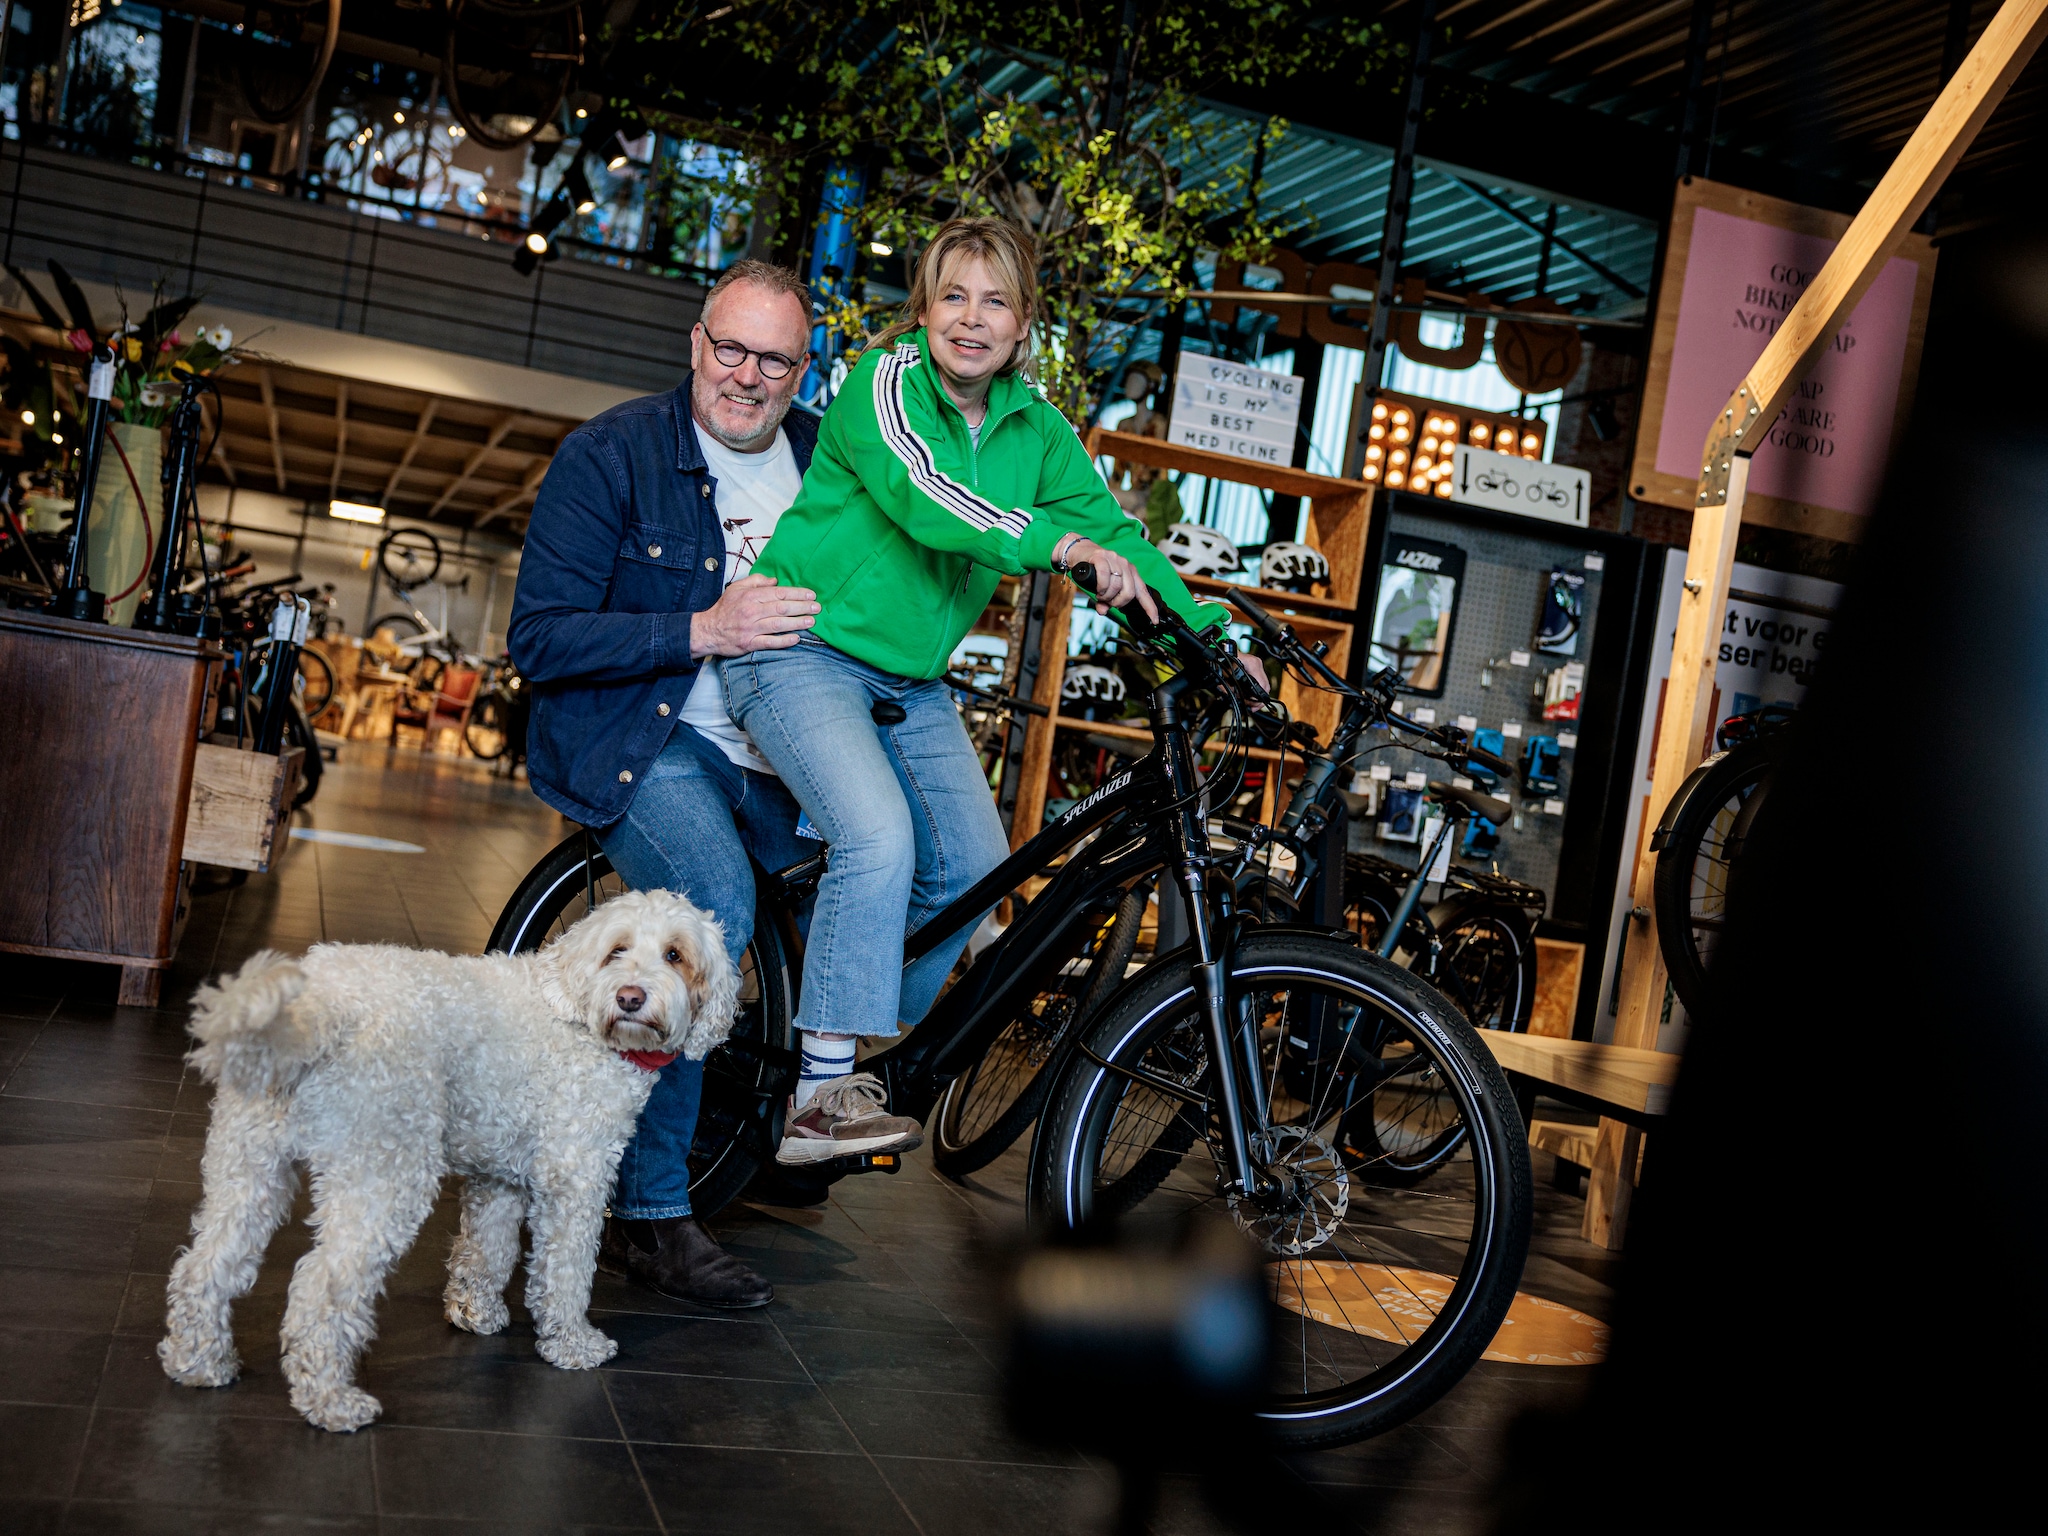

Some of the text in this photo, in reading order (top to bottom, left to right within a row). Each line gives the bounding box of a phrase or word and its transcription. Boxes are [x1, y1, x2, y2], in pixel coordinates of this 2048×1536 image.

[1211, 366, 1294, 395] CYCLING
[1206, 389, 1269, 412] IS MY
[1210, 414, 1255, 432] BEST
[1790, 407, 1837, 432] ARE
[1770, 428, 1835, 458] GOOD
[1745, 616, 1808, 646] voor
[1062, 770, 1133, 827] SPECIALIZED
